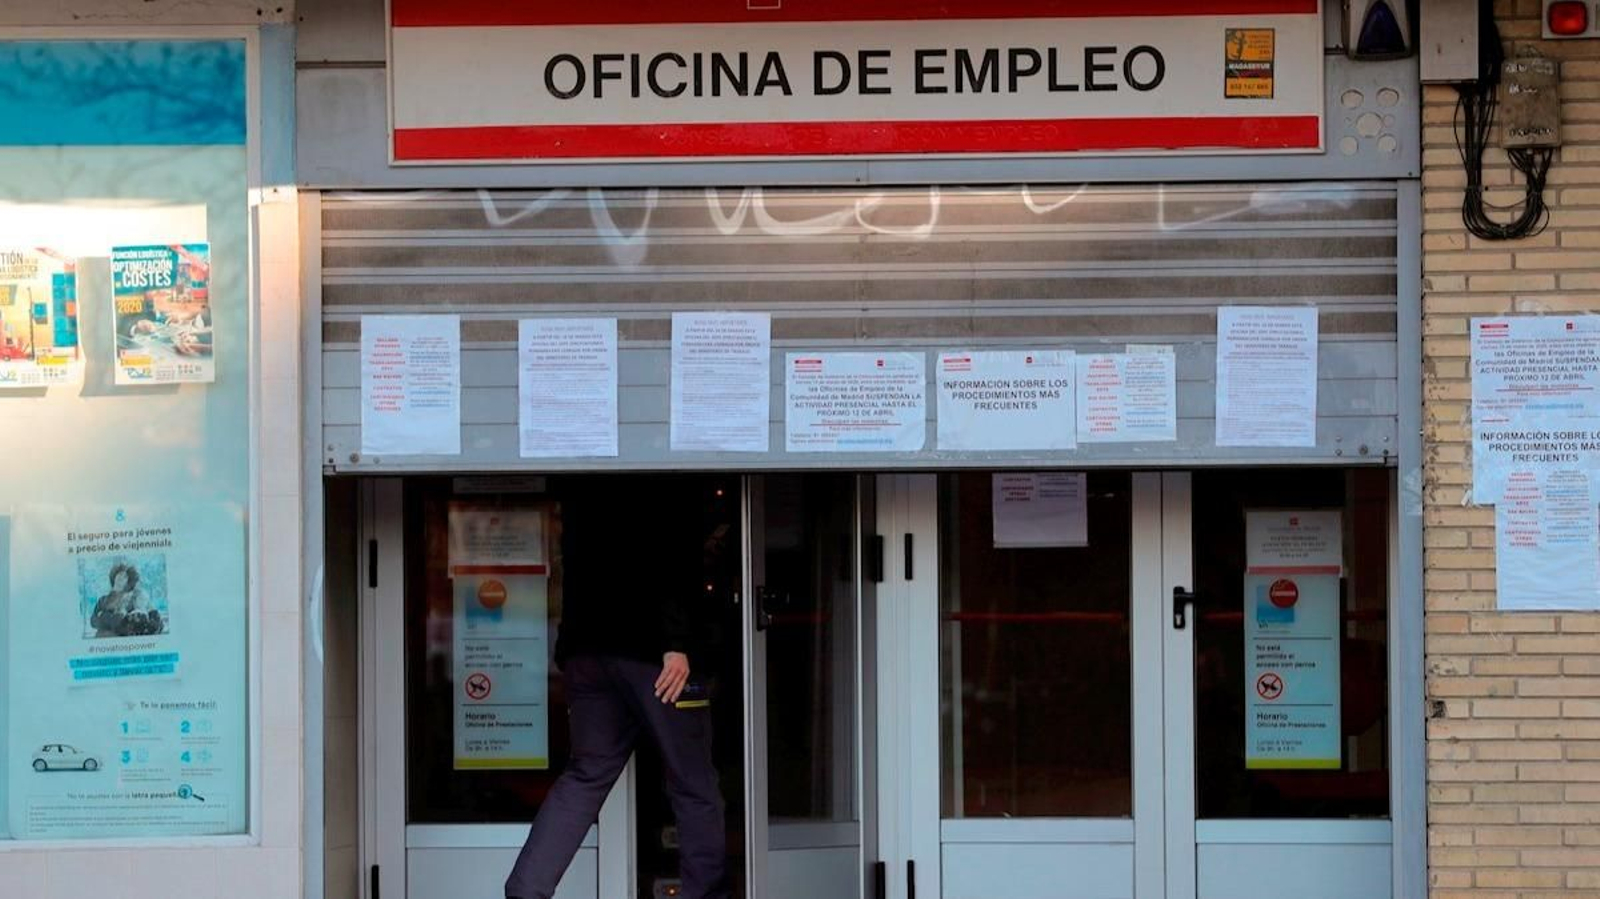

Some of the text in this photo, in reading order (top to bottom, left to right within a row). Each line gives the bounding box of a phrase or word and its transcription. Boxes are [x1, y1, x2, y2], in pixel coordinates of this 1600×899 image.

[544, 44, 1165, 99] OFICINA DE EMPLEO
[114, 260, 172, 272] OPTIMIZACIÓN
[122, 272, 171, 288] COSTES
[116, 298, 142, 312] 2020
[944, 379, 1068, 389] INFORMACIÓN SOBRE LOS
[952, 390, 1060, 400] PROCEDIMIENTOS MÁS
[974, 401, 1038, 410] FRECUENTES
[1480, 431, 1550, 440] INFORMACIÓN
[1489, 443, 1578, 451] PROCEDIMIENTOS
[1512, 453, 1578, 462] FRECUENTES
[67, 527, 172, 542] El seguro para jóvenes
[76, 544, 106, 554] precio
[108, 542, 120, 550] de
[123, 539, 172, 551] viejennials
[120, 721, 129, 734] 1
[181, 720, 190, 733] 2
[121, 750, 131, 764] 3
[181, 750, 190, 763] 4
